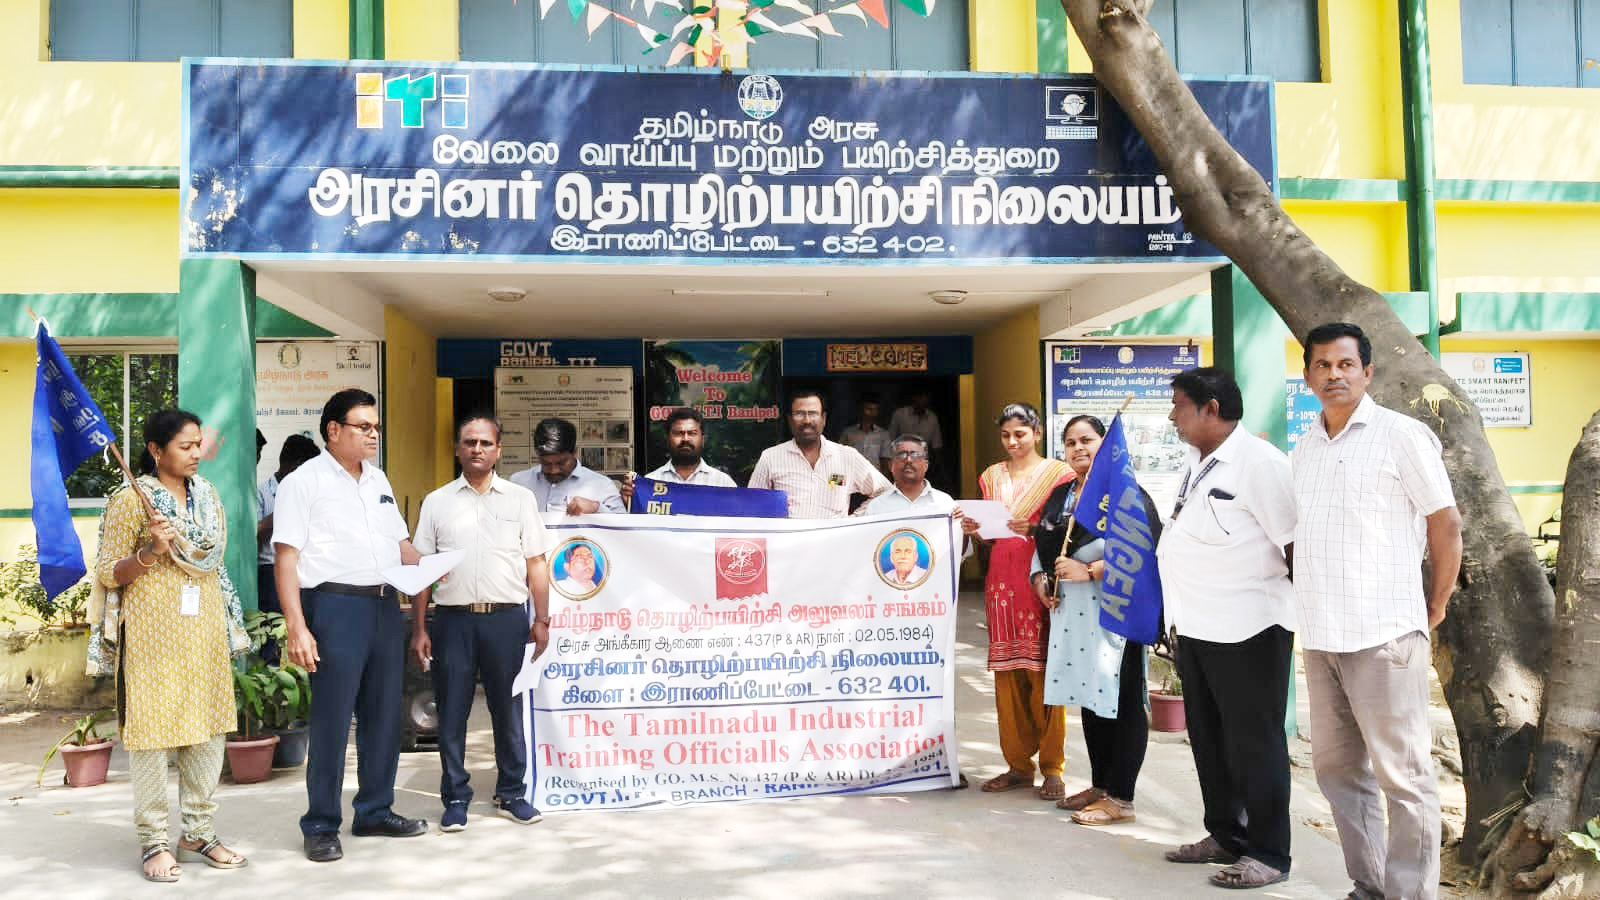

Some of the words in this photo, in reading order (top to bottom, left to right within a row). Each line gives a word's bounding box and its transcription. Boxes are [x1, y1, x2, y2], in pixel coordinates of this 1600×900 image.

[633, 110, 784, 144] தமிழ்நாடு
[808, 115, 880, 143] அரசு
[432, 134, 560, 165] வேலை
[580, 137, 697, 171] வாய்ப்பு
[714, 140, 825, 175] மற்றும்
[842, 140, 1061, 175] பயிற்சித்துறை
[308, 168, 543, 227] அரசினர்
[555, 172, 943, 235] தொழிற்பயிற்சி
[951, 174, 1183, 226] நிலையம்
[550, 223, 796, 252] இராணிப்பேட்டை
[823, 235, 879, 254] 632
[883, 235, 958, 254] 402.
[500, 341, 553, 357] GOVT
[831, 346, 925, 367] WELCOME
[676, 367, 753, 384] Welcome
[703, 386, 728, 402] To
[546, 603, 632, 635] மிழ்நாடு
[637, 602, 782, 634] தொழிற்பயிற்சி
[788, 595, 878, 628] அலுவலர்
[883, 593, 947, 618] சங்கம்
[556, 636, 590, 656] (அரசு
[594, 633, 650, 653] அங்கீகார
[707, 632, 734, 649] எண்
[796, 631, 815, 647] AR)
[816, 628, 845, 649] நாள்
[855, 624, 934, 644] 02.05.1984)
[543, 654, 648, 683] அரசினர்
[652, 648, 827, 681] தொழிற்பயிற்சி
[831, 643, 945, 675] நிலையம்,
[562, 684, 624, 705] கிளை
[640, 679, 820, 705] இராணிப்பேட்டை
[838, 676, 883, 695] 632
[888, 675, 931, 693] 401.
[561, 713, 615, 738] The
[624, 709, 777, 737] Tamilnadu
[789, 703, 924, 732] Industrial
[538, 742, 656, 771] Training
[664, 738, 790, 766] Officialls
[632, 774, 649, 789] by
[804, 770, 817, 782] &
[823, 769, 853, 784] AR)
[671, 785, 747, 802] BRANCH
